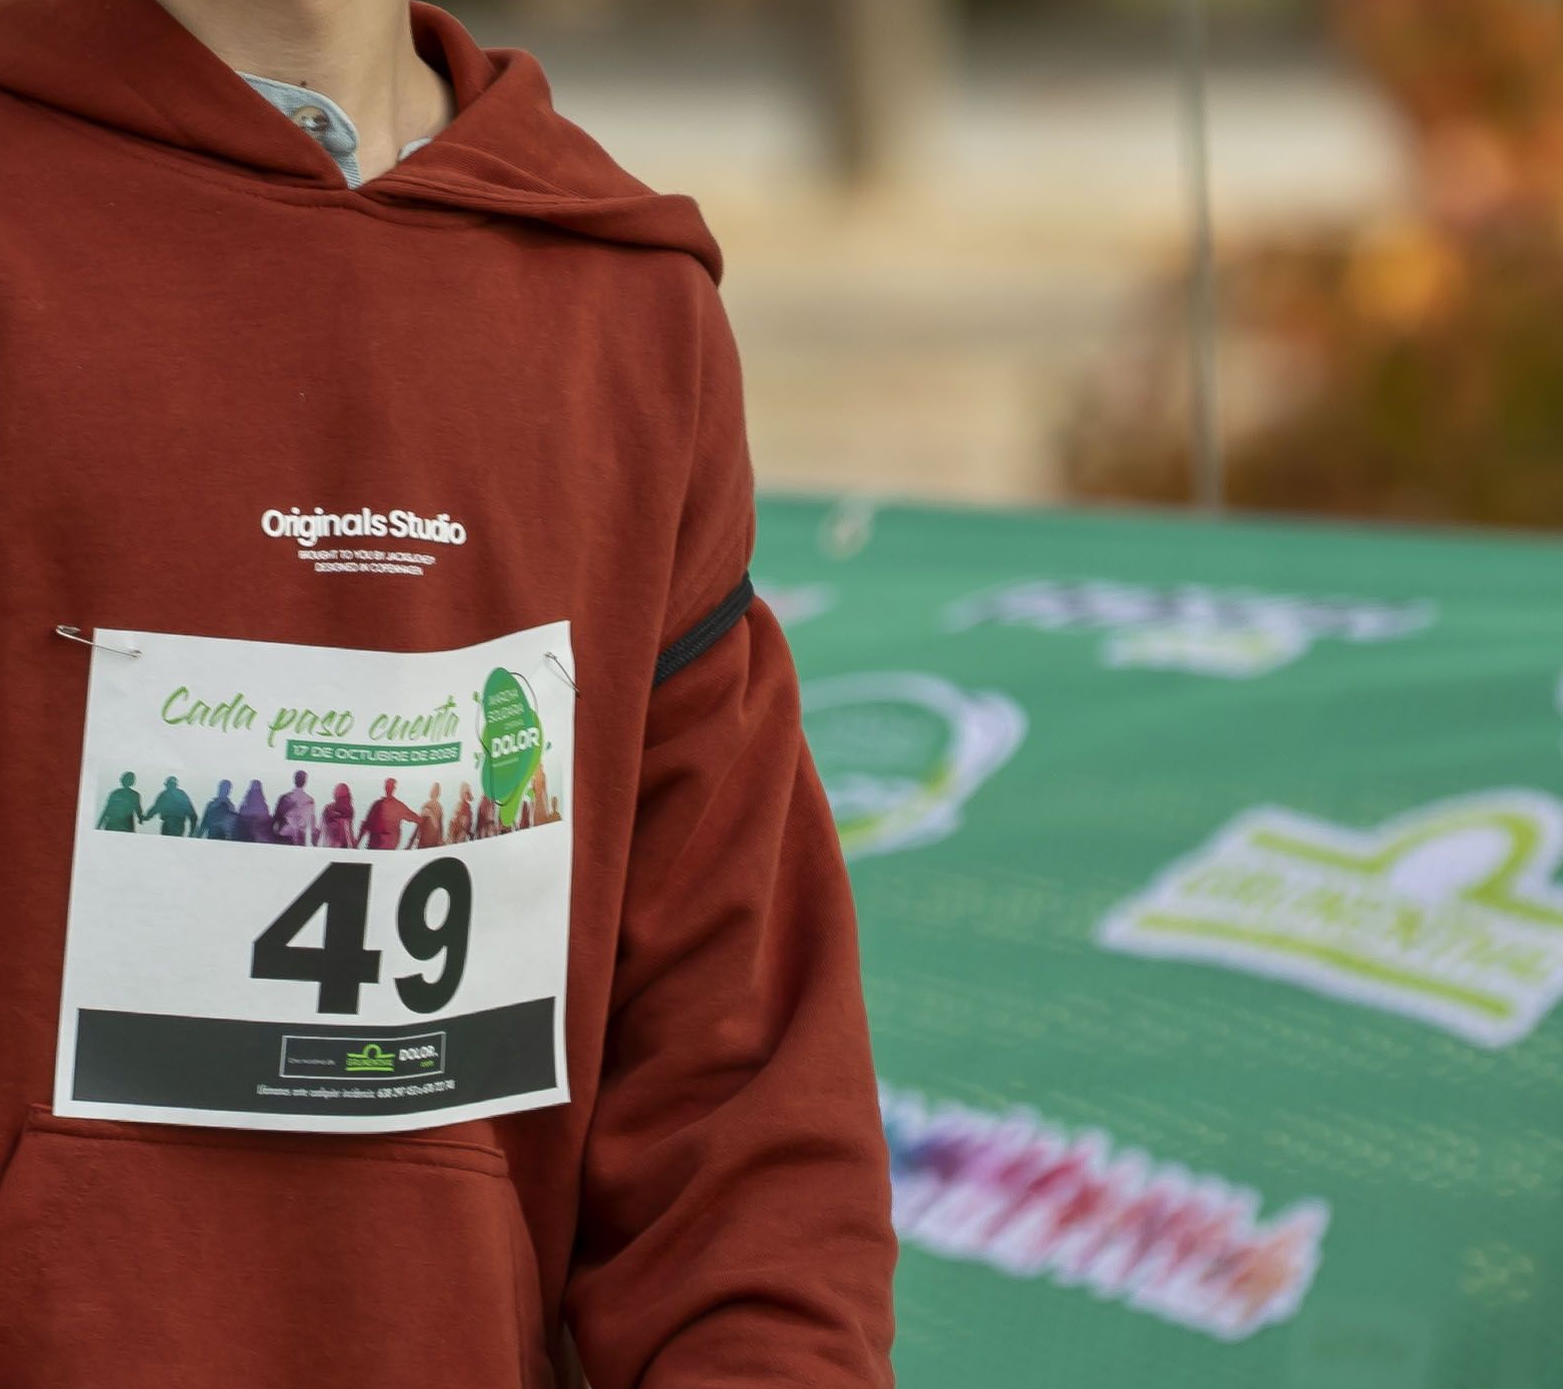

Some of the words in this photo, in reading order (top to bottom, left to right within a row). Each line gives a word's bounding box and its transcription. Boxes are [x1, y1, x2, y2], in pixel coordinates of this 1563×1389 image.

[261, 507, 389, 547] Originals
[388, 510, 467, 545] Studio
[162, 686, 258, 733] Cada
[267, 707, 354, 748] paso
[369, 695, 460, 742] cuenta
[311, 746, 334, 759] DE
[335, 748, 409, 762] OCTUBRE
[491, 727, 540, 758] DOLOR
[250, 856, 472, 1015] 49
